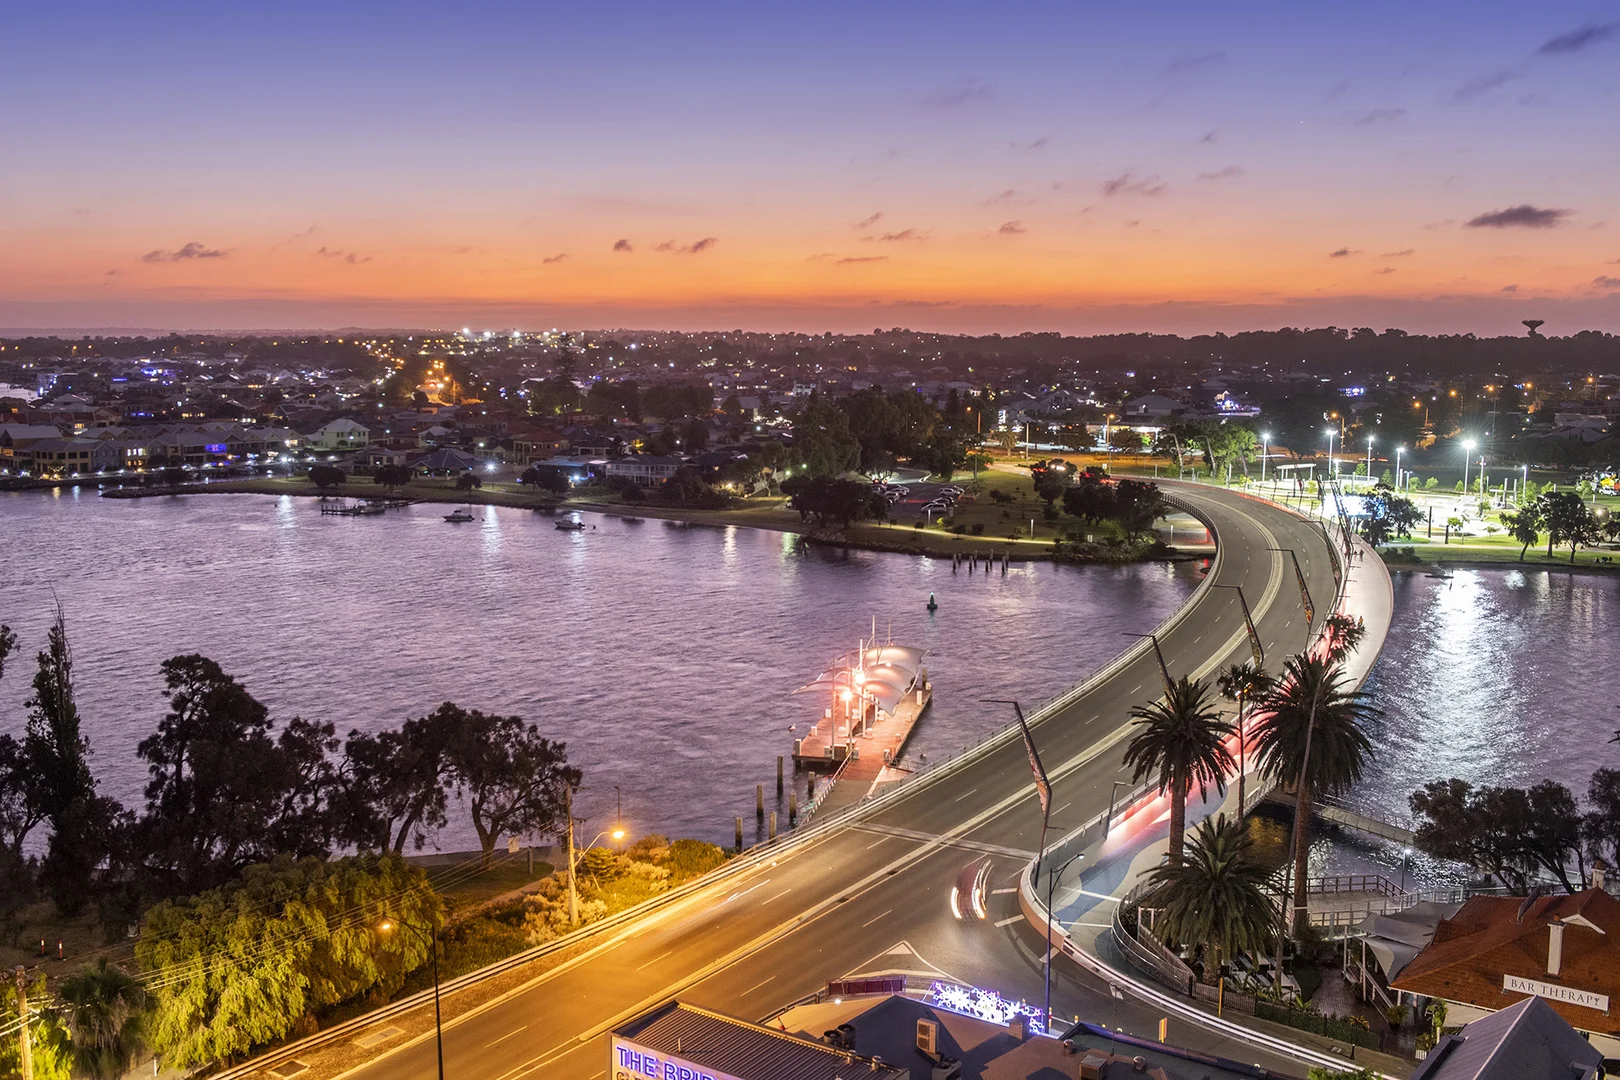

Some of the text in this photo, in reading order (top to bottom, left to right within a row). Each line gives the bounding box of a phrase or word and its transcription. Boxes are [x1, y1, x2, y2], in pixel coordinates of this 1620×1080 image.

[1511, 979, 1600, 1006] BAR THERAPY
[616, 1046, 657, 1077] THE
